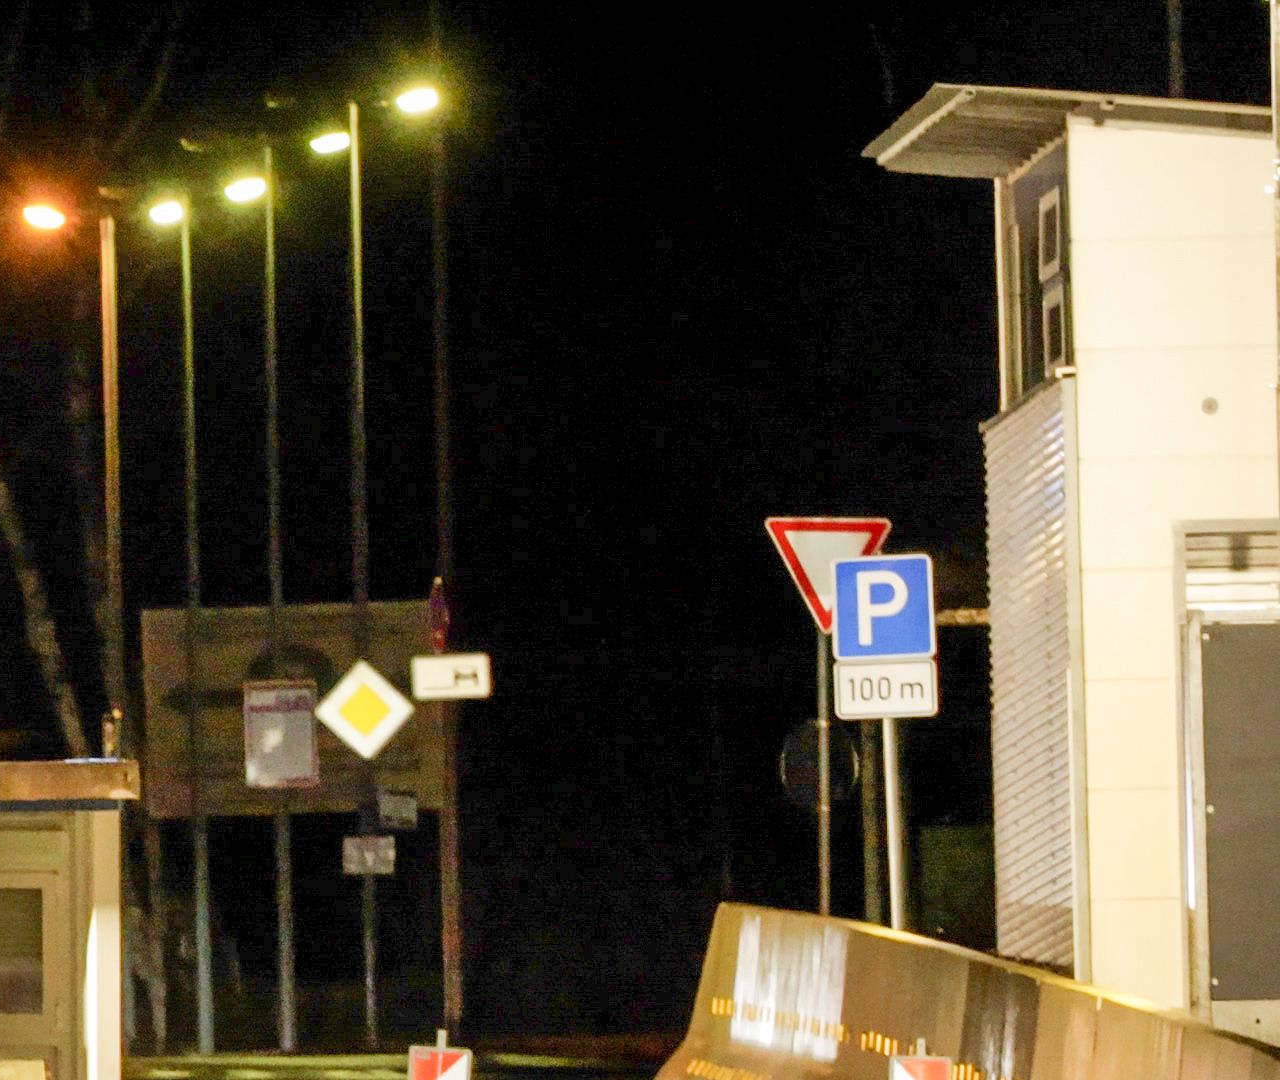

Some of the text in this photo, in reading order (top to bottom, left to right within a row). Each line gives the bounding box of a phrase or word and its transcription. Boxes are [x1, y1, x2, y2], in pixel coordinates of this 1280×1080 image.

[856, 570, 909, 647] P
[848, 676, 925, 702] 100 m
